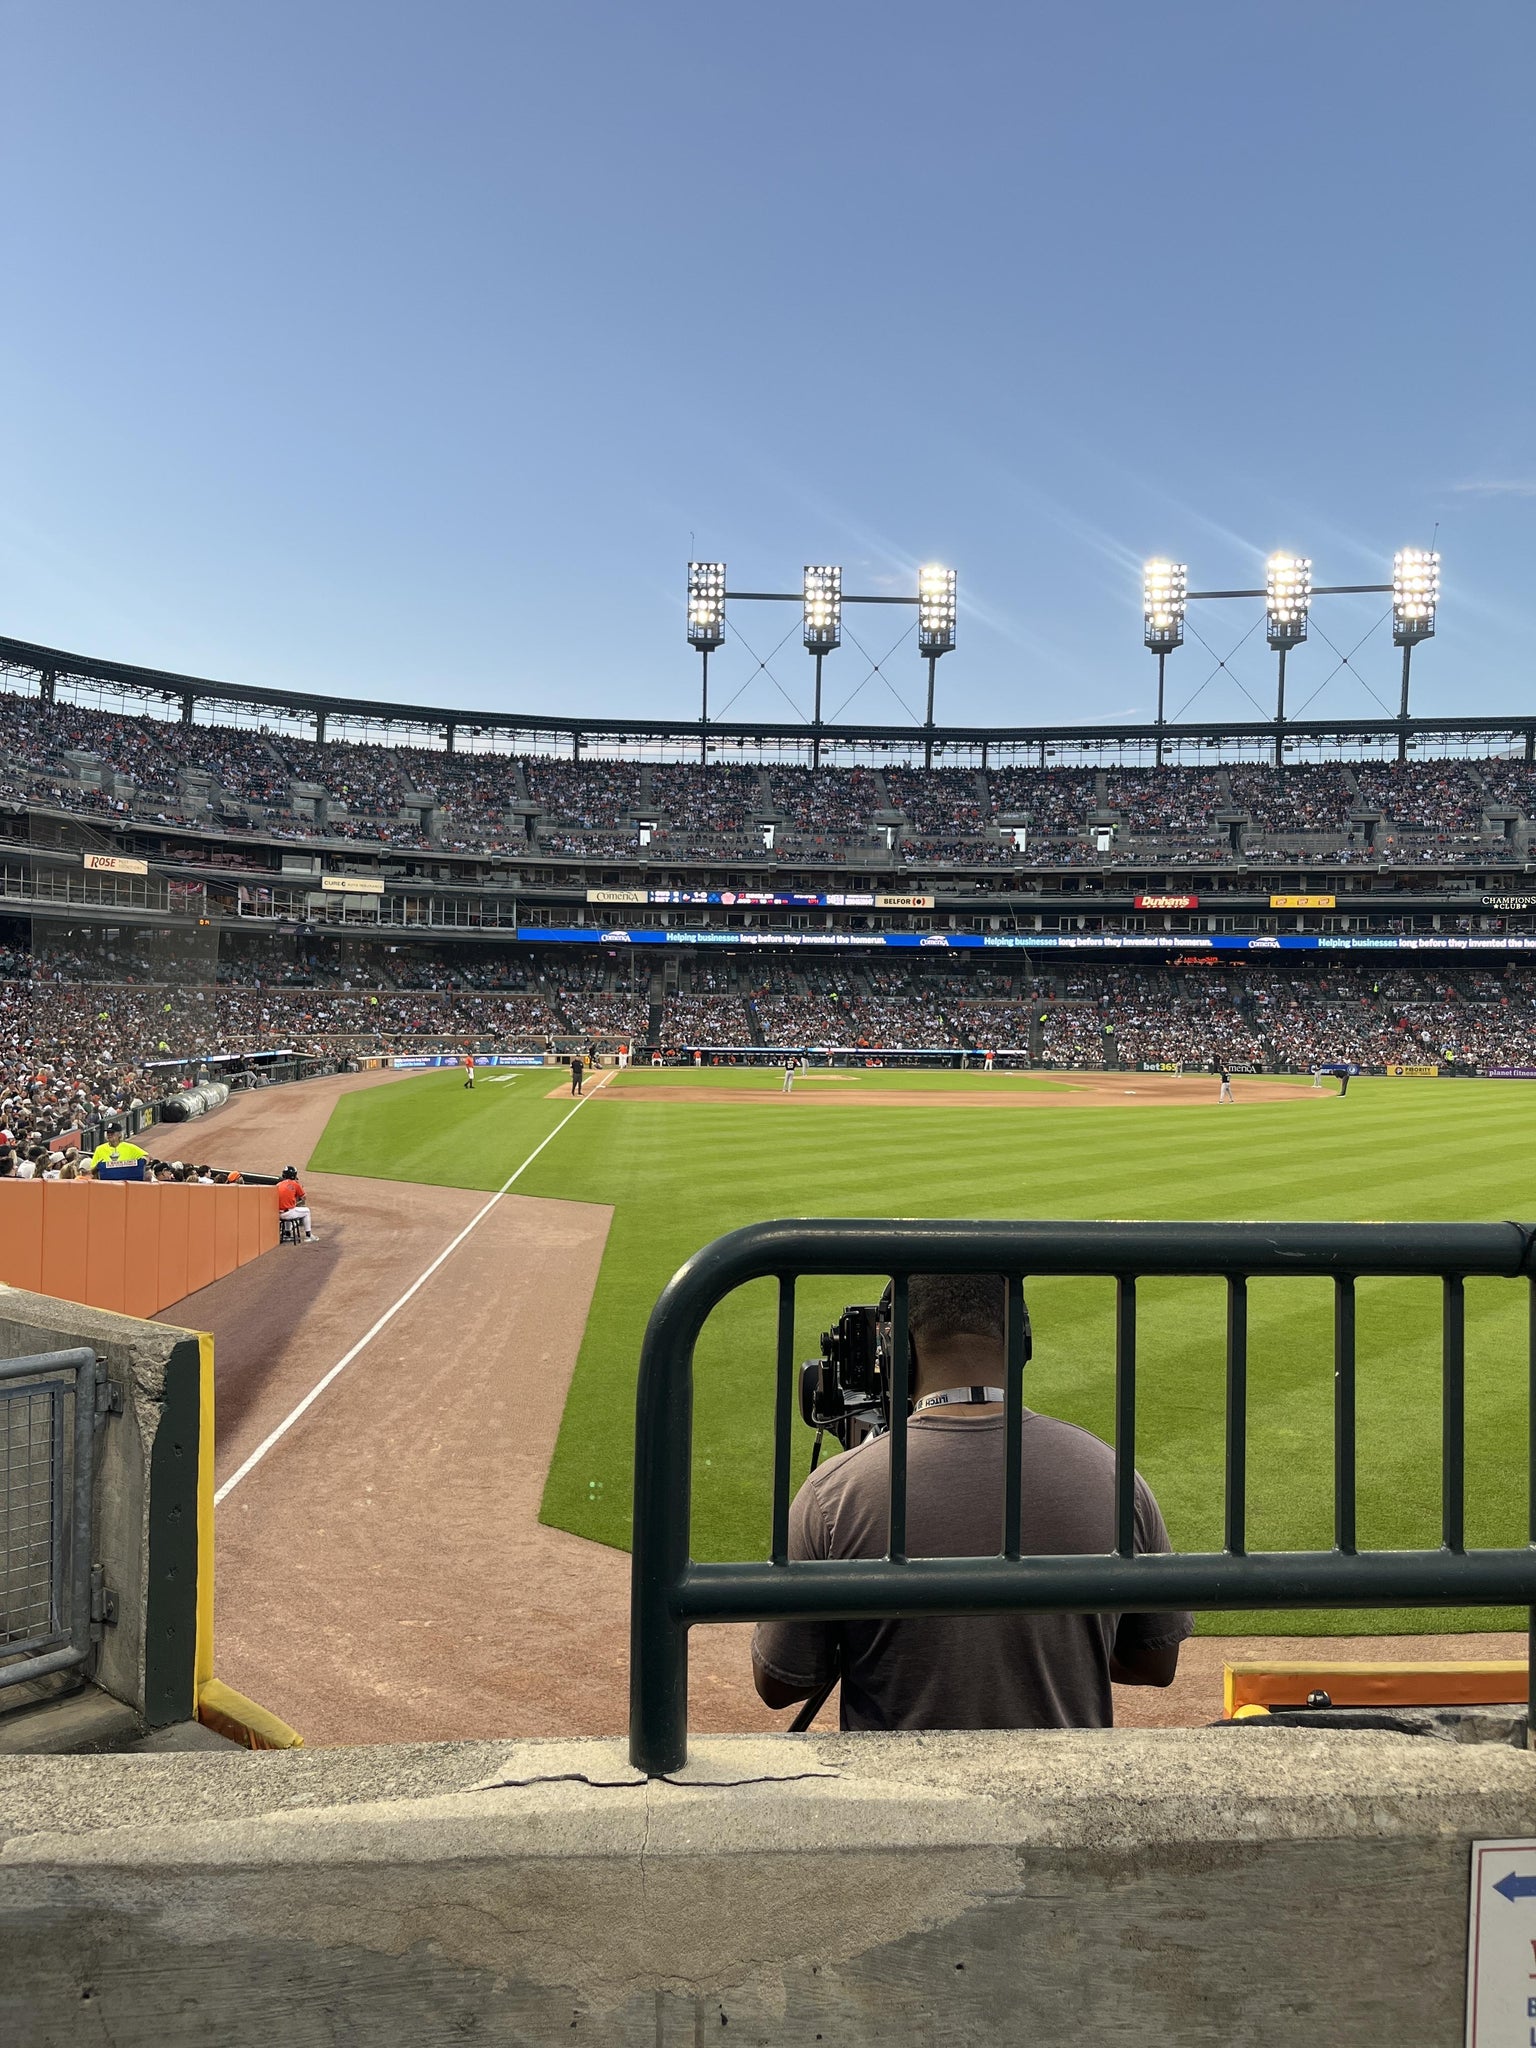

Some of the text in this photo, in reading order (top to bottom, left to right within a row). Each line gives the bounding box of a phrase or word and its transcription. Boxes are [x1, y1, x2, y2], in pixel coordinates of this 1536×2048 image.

[90, 856, 116, 868] ROSE
[1141, 896, 1190, 906] Dunham's
[1481, 896, 1536, 905] CHAMPIONS
[666, 932, 697, 943] Helping
[698, 933, 739, 943] businesses
[740, 934, 757, 944] long
[758, 934, 783, 943] before
[784, 934, 801, 945] they
[802, 935, 836, 944] invented
[837, 935, 850, 944] the
[984, 936, 1014, 947] Helping
[1015, 937, 1057, 946] businesses
[1058, 937, 1076, 948] long
[1077, 937, 1103, 946] before
[1104, 937, 1122, 948] they
[1123, 937, 1158, 946] invented
[1159, 937, 1173, 947] the
[1318, 938, 1351, 949] Helping
[1351, 938, 1398, 947] businesses
[1399, 938, 1418, 949] long
[1418, 938, 1447, 948] before
[1448, 938, 1468, 949] they
[1468, 938, 1507, 948] invented
[1508, 938, 1523, 948] the
[1143, 1062, 1177, 1071] bet365
[1489, 1069, 1512, 1077] planet
